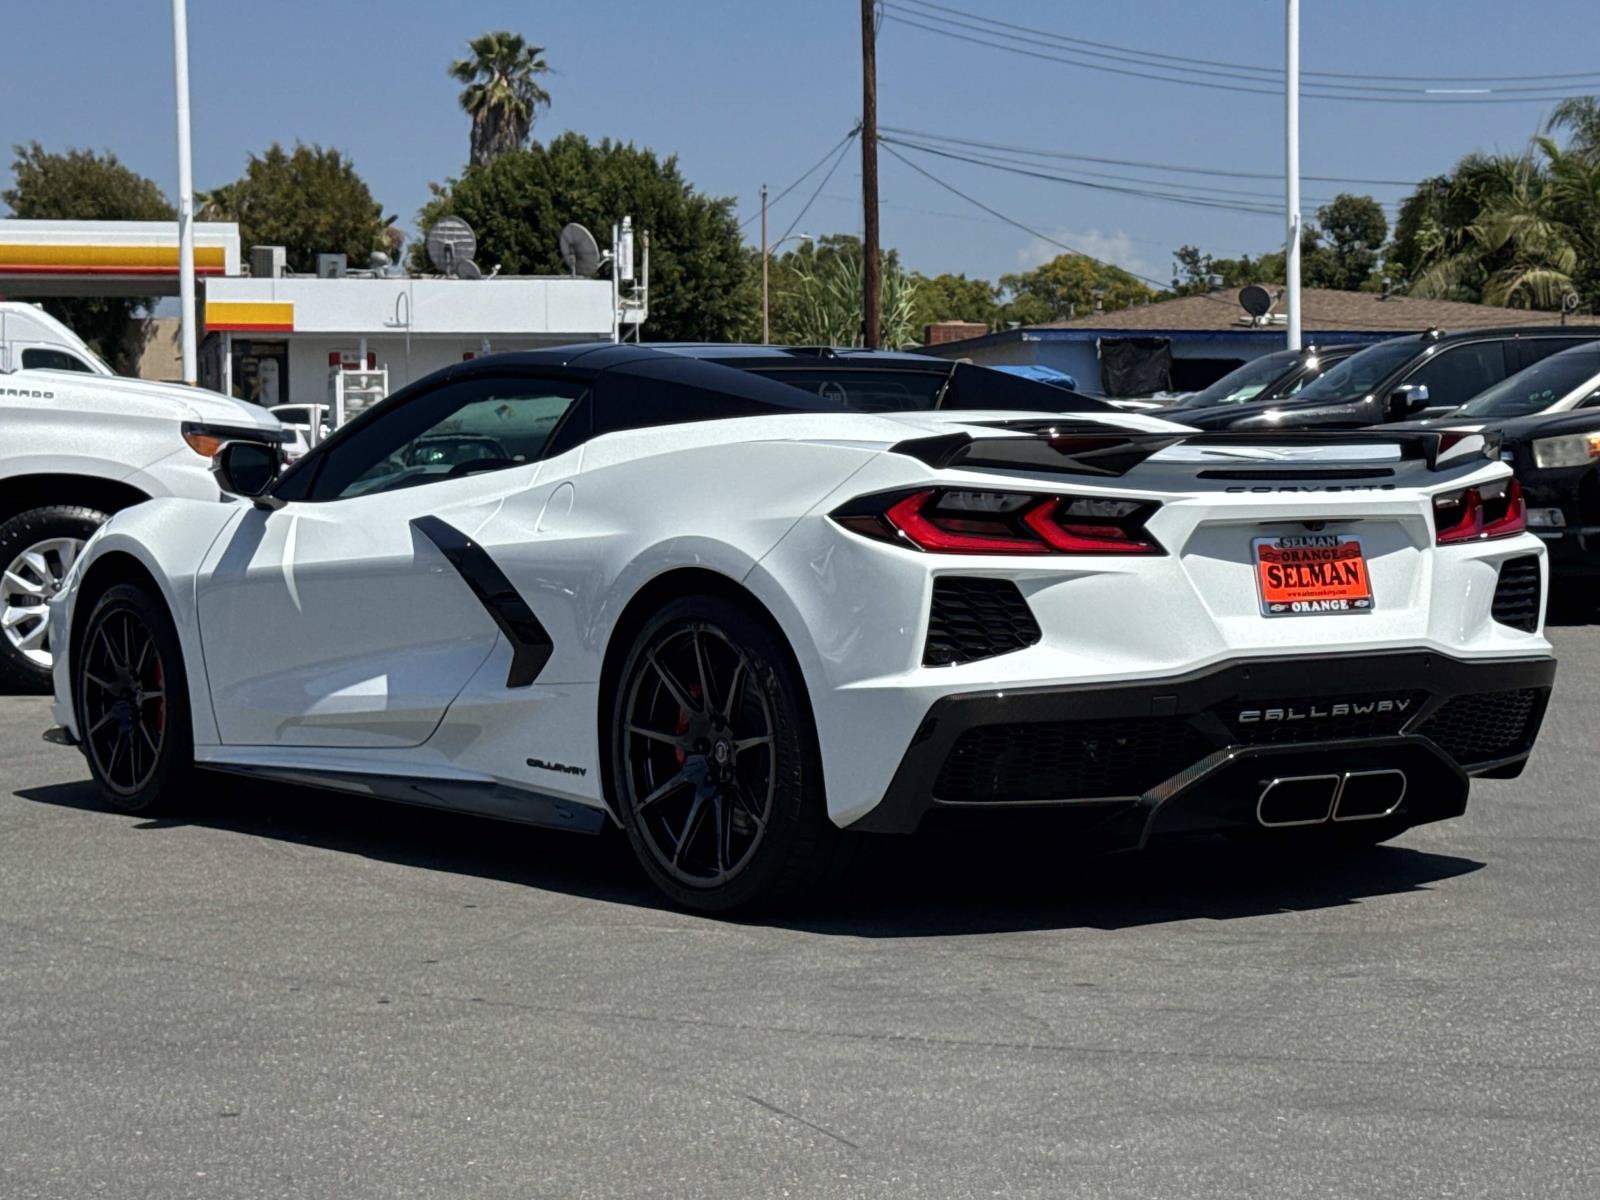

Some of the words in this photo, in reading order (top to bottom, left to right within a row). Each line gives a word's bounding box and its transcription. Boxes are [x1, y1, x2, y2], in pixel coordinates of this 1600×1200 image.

[1225, 484, 1396, 493] CORVETTE
[1281, 535, 1338, 548] SELMAN
[1281, 548, 1340, 562] ORANGE
[1267, 561, 1360, 589] SELMAN
[1291, 599, 1350, 612] ORANGE
[1238, 698, 1411, 723] CALLAWAY
